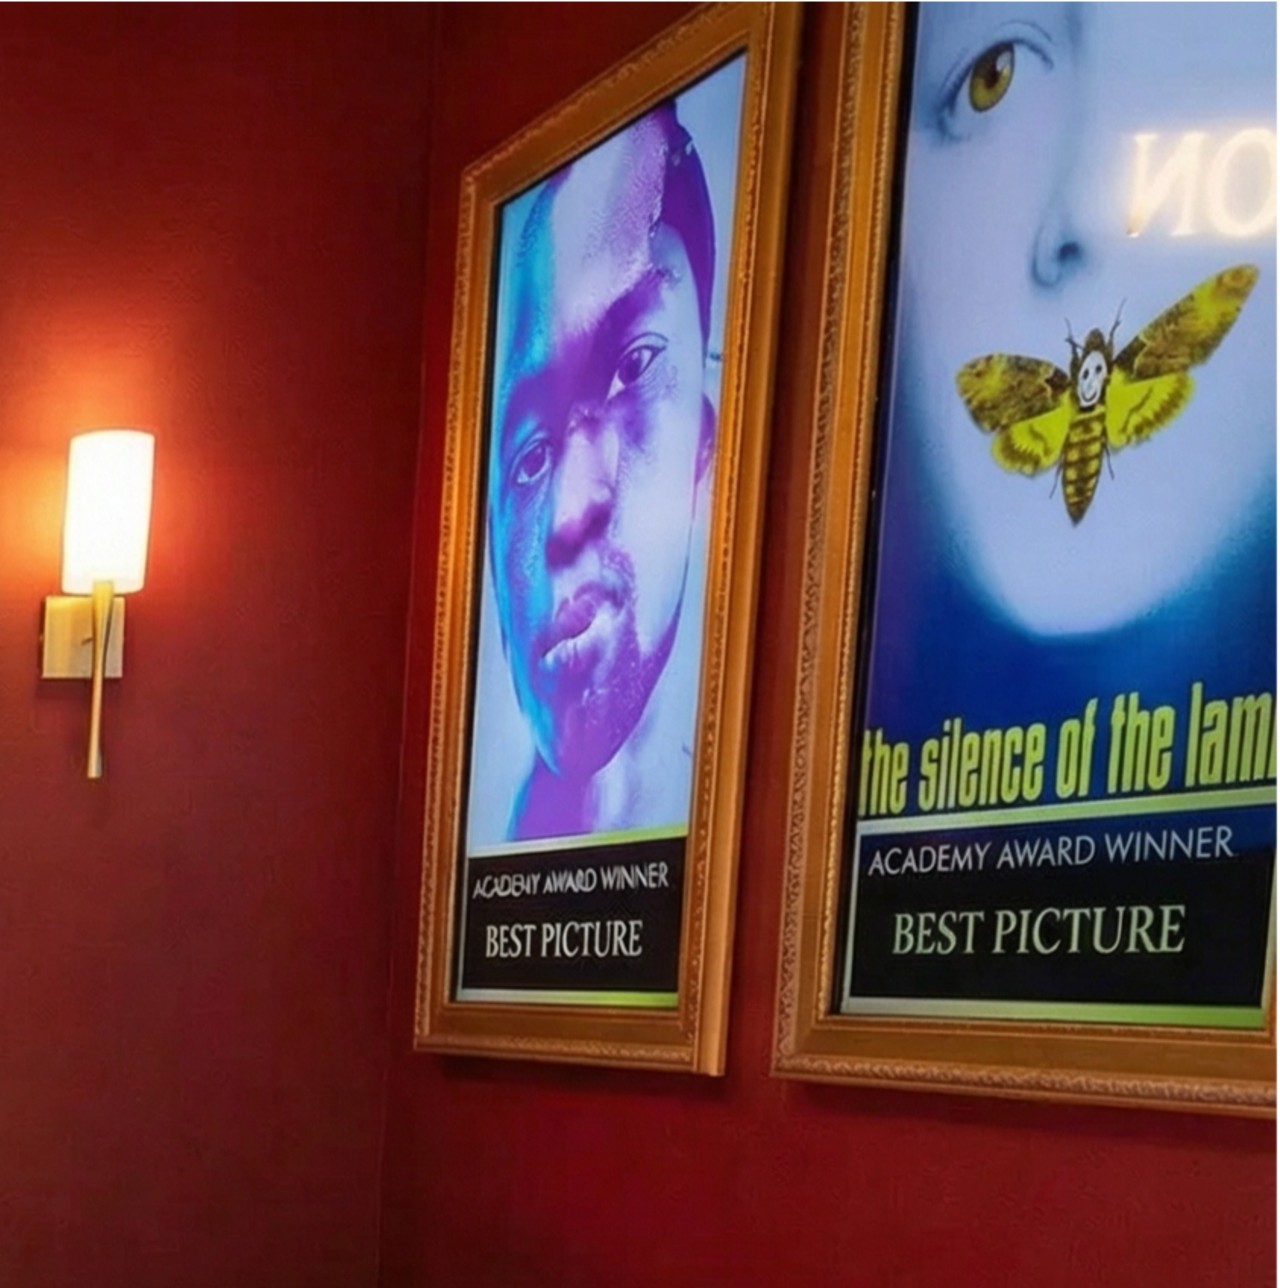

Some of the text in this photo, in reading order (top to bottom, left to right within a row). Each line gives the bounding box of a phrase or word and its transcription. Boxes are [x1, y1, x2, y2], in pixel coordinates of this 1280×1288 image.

[858, 728, 909, 816] the
[918, 718, 1047, 812] silence
[1055, 698, 1098, 800] of
[1107, 691, 1176, 794] the
[868, 824, 1234, 877] ACADEMY AWARD WINNER
[542, 867, 597, 895] AWARD
[599, 861, 669, 890] WINNER
[485, 919, 643, 959] BEST PICTURE
[891, 904, 1186, 956] BEST PICTURE
